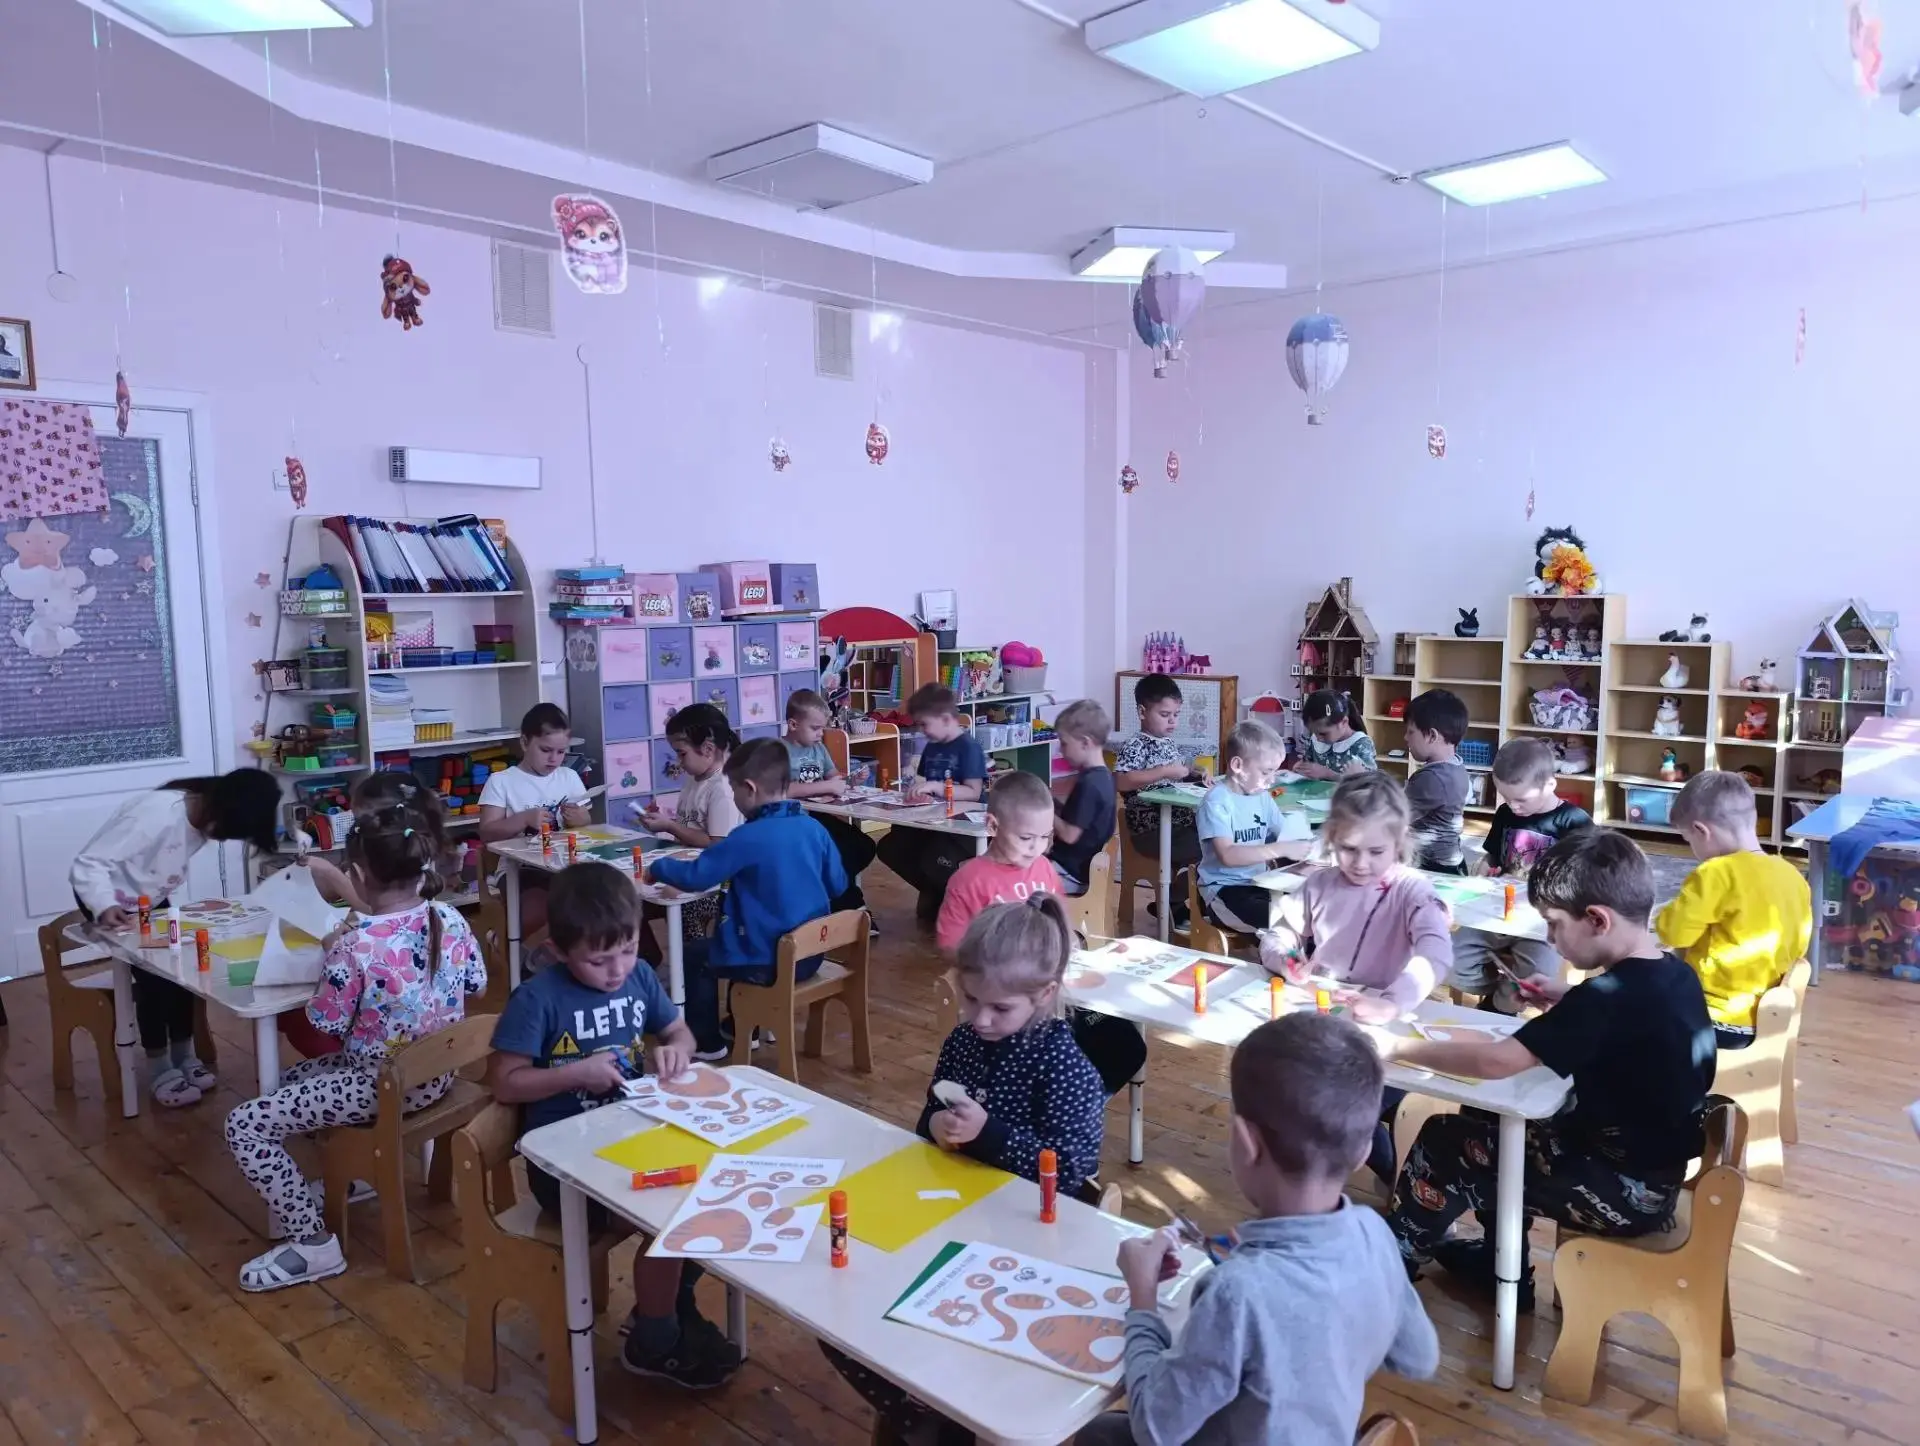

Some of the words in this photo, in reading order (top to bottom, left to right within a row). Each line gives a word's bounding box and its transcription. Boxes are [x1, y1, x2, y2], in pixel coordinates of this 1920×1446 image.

[743, 586, 765, 599] LEGO
[645, 599, 667, 611] LEGO
[1233, 826, 1262, 844] PUMA
[573, 996, 646, 1040] LET'S
[1572, 1184, 1632, 1226] racer
